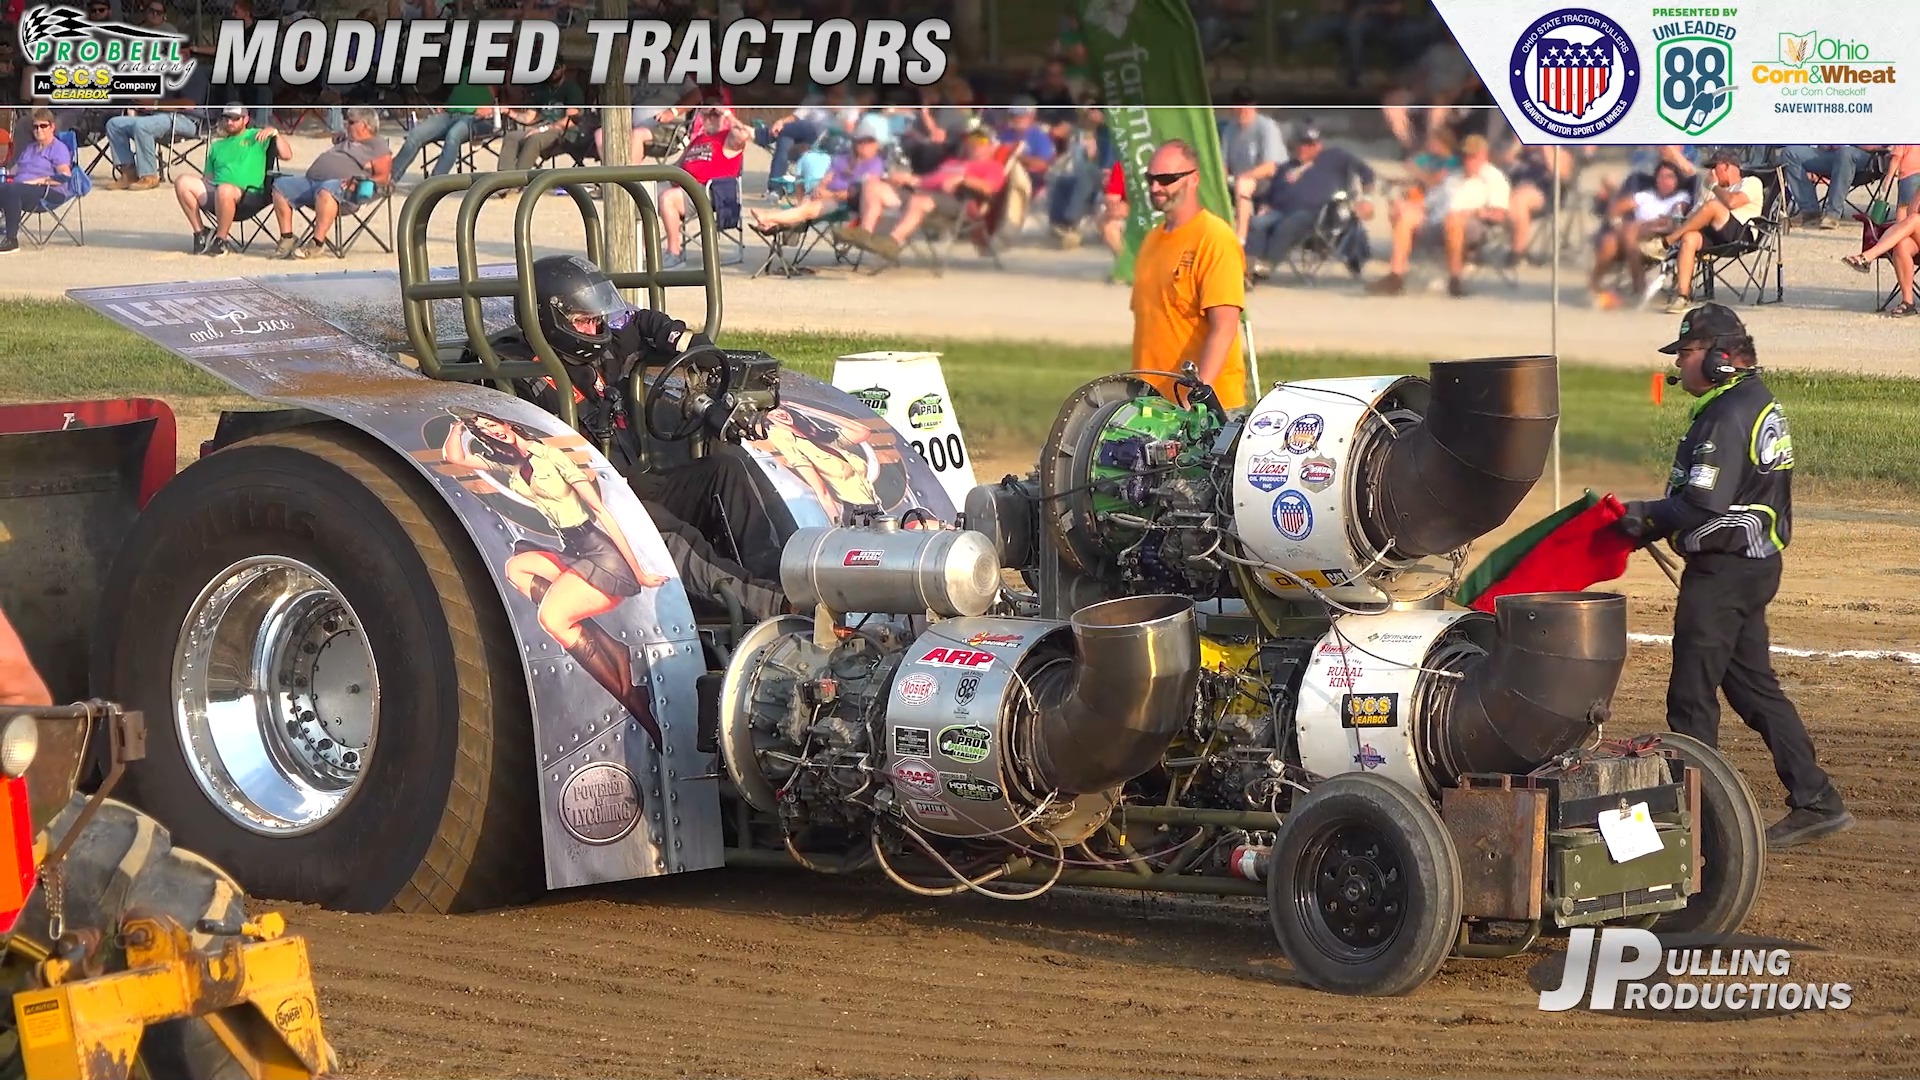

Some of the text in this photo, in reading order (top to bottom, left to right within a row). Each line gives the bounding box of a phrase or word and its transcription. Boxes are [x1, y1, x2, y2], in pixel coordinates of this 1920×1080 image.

[190, 310, 296, 343] and Lace
[1252, 463, 1288, 474] LUCAS
[921, 647, 995, 667] ARP
[1327, 666, 1363, 677] RURAL
[903, 681, 932, 697] MOSIER
[957, 678, 978, 697] 88
[1328, 678, 1356, 688] KING
[1353, 698, 1389, 714] SCS
[1350, 714, 1389, 725] GEARBOX
[956, 736, 980, 748] PRO
[573, 780, 624, 801] POWERED
[956, 788, 995, 798] SECRET
[573, 802, 631, 827] LYCOMING
[916, 803, 948, 814] OPTIMA
